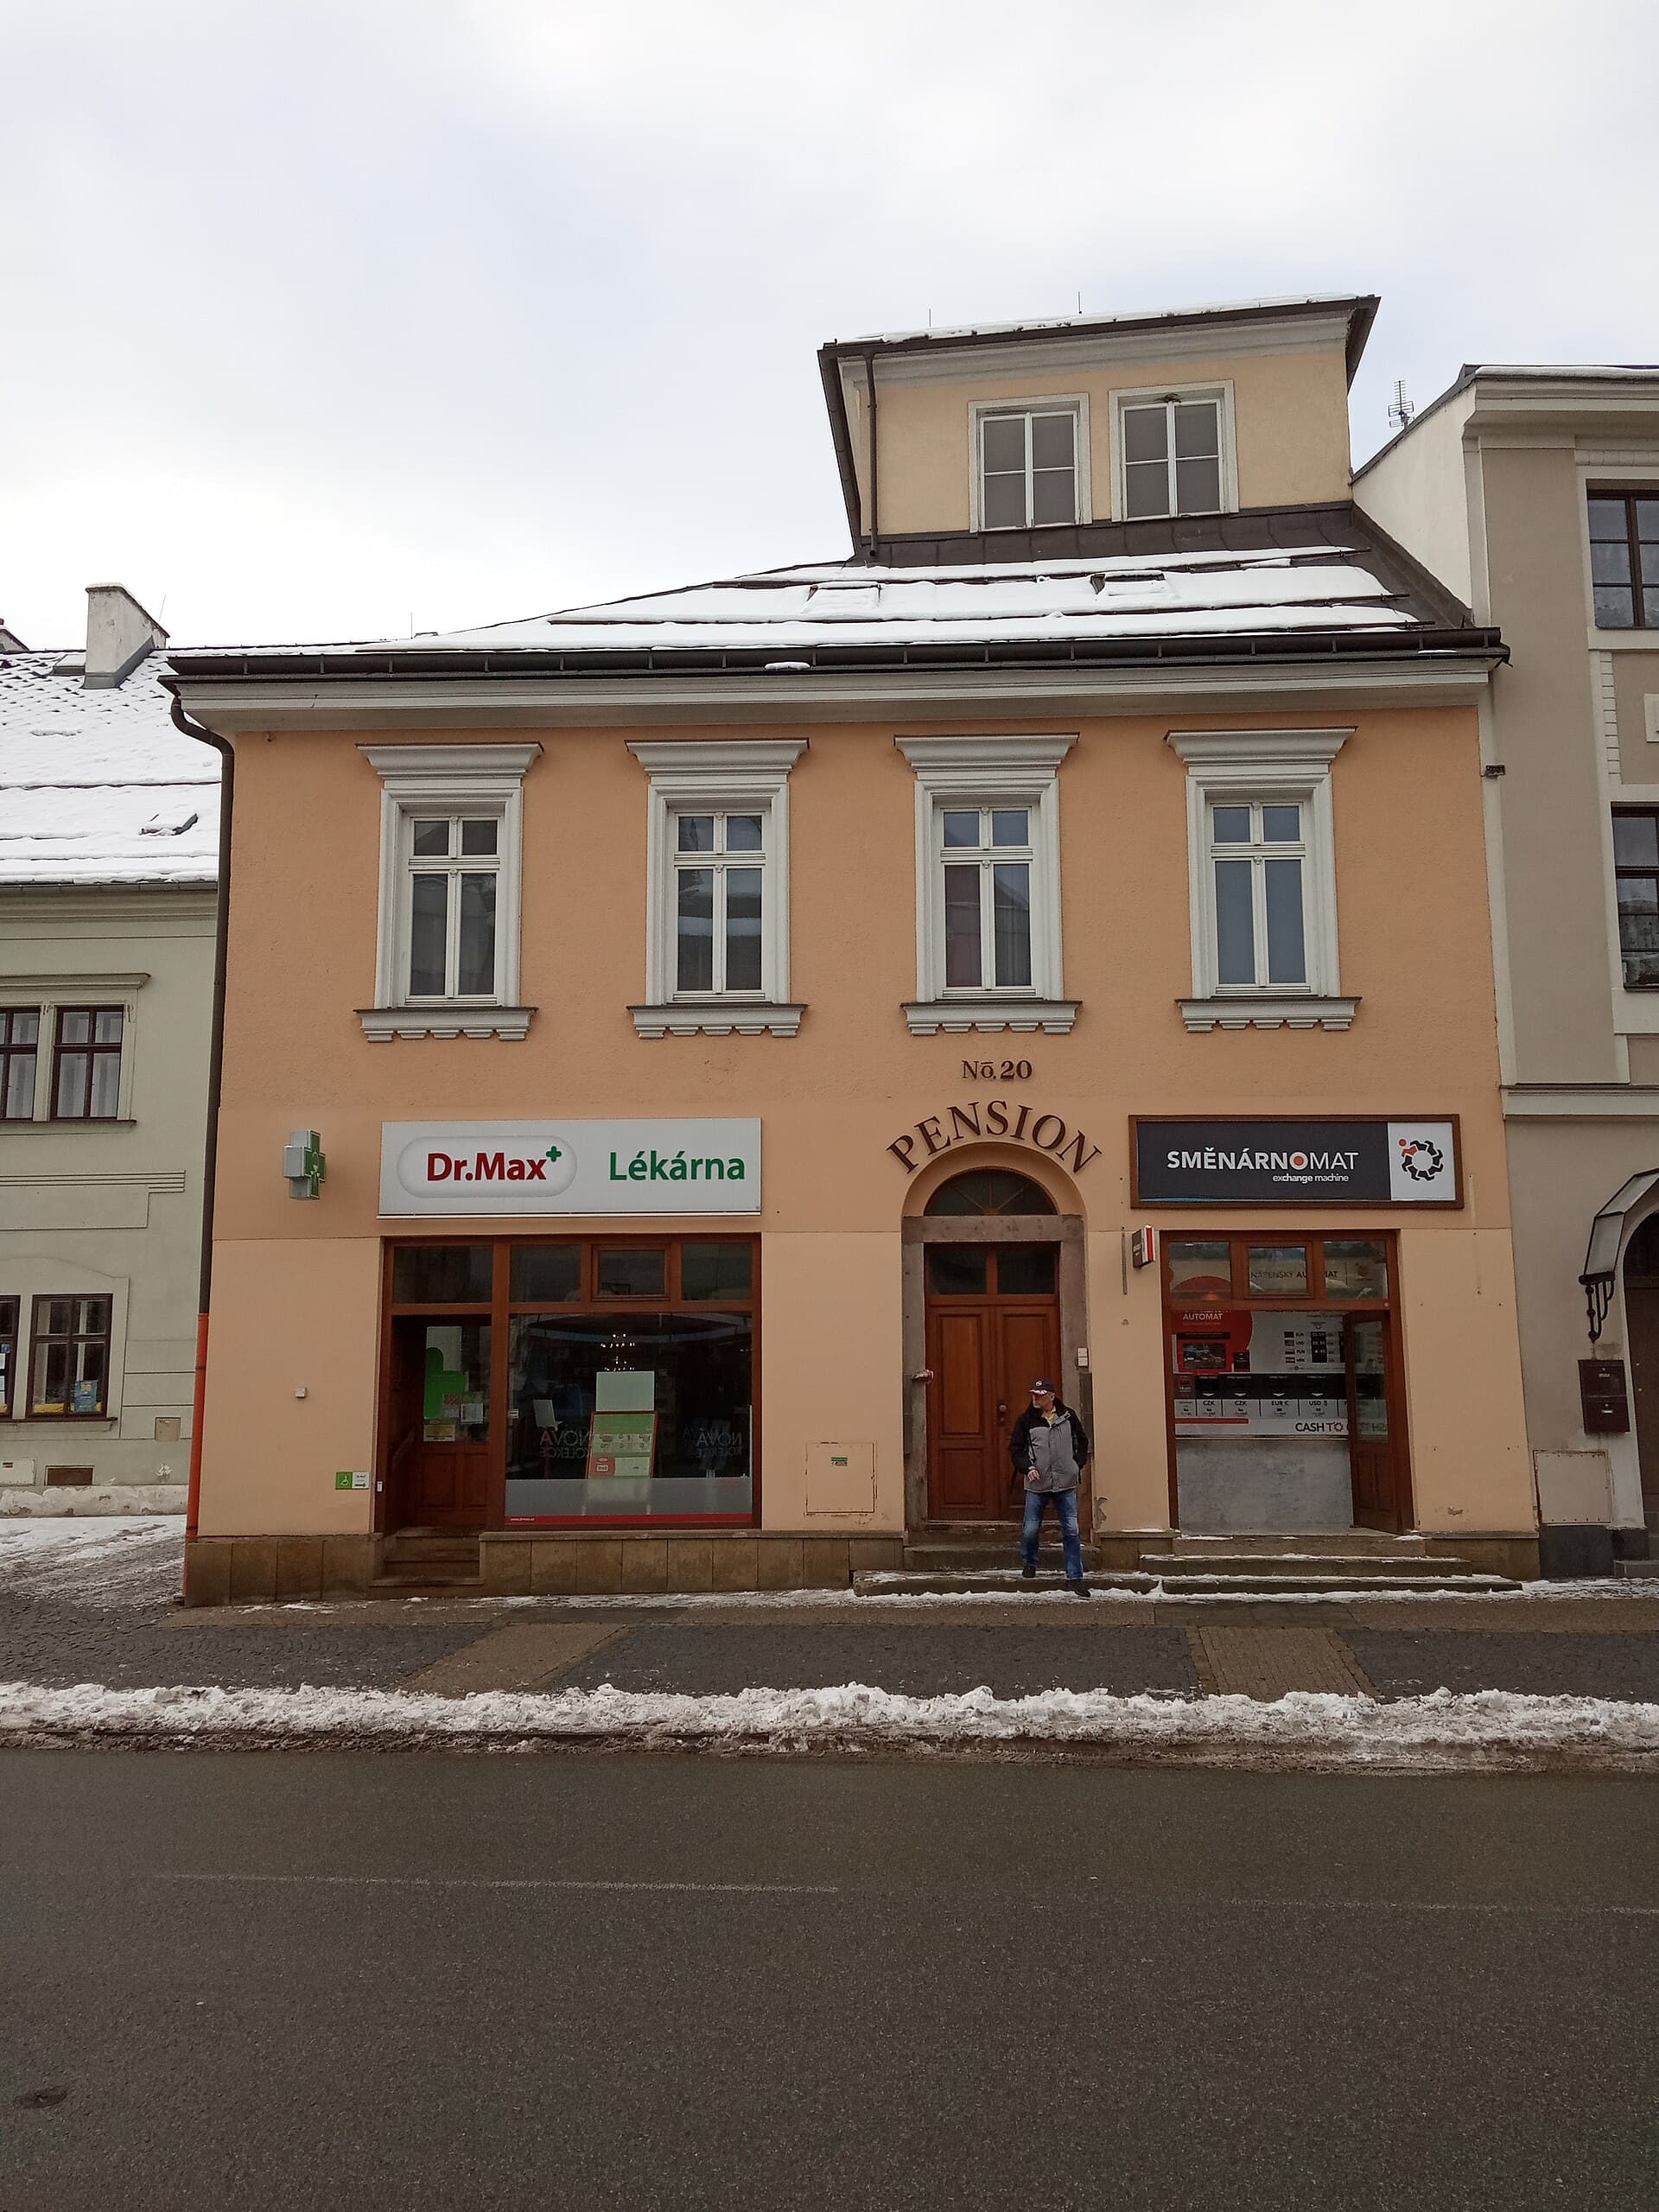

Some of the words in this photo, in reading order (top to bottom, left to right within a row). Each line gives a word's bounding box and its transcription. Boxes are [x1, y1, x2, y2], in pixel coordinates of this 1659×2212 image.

[886, 1099, 1102, 1175] PENSION
[609, 1150, 746, 1181] Lékárna
[1166, 1147, 1359, 1171] SMĚNÁRNOMAT
[1272, 1173, 1313, 1184] exchange
[1314, 1173, 1350, 1183] machine
[1182, 1313, 1224, 1321] AUTOMAT
[1295, 1422, 1325, 1433] CASH
[1326, 1421, 1344, 1433] TO
